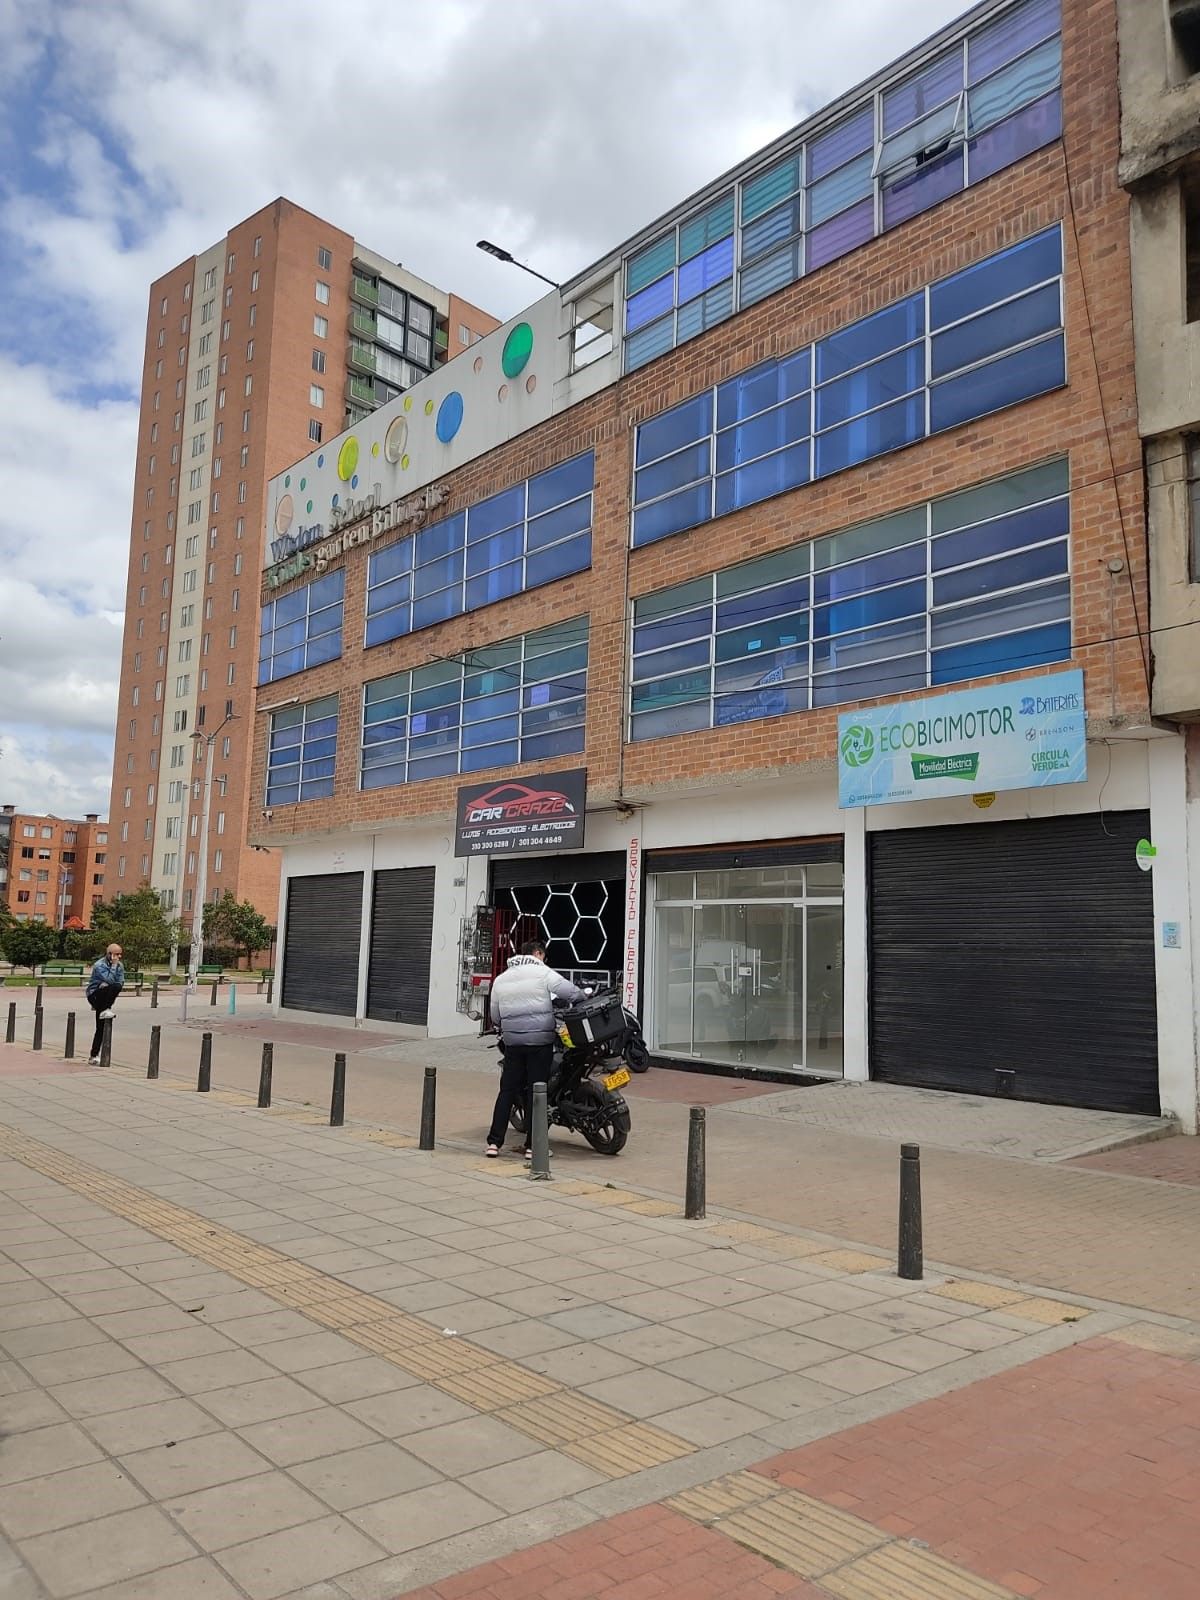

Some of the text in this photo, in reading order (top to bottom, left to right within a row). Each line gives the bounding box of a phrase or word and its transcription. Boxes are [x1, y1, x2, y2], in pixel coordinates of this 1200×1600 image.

[880, 705, 1015, 752] ECOBICIMOTOR
[1031, 748, 1069, 763] CIRCULA
[1031, 760, 1059, 772] VERDE
[469, 798, 567, 823] CAR CRAZE
